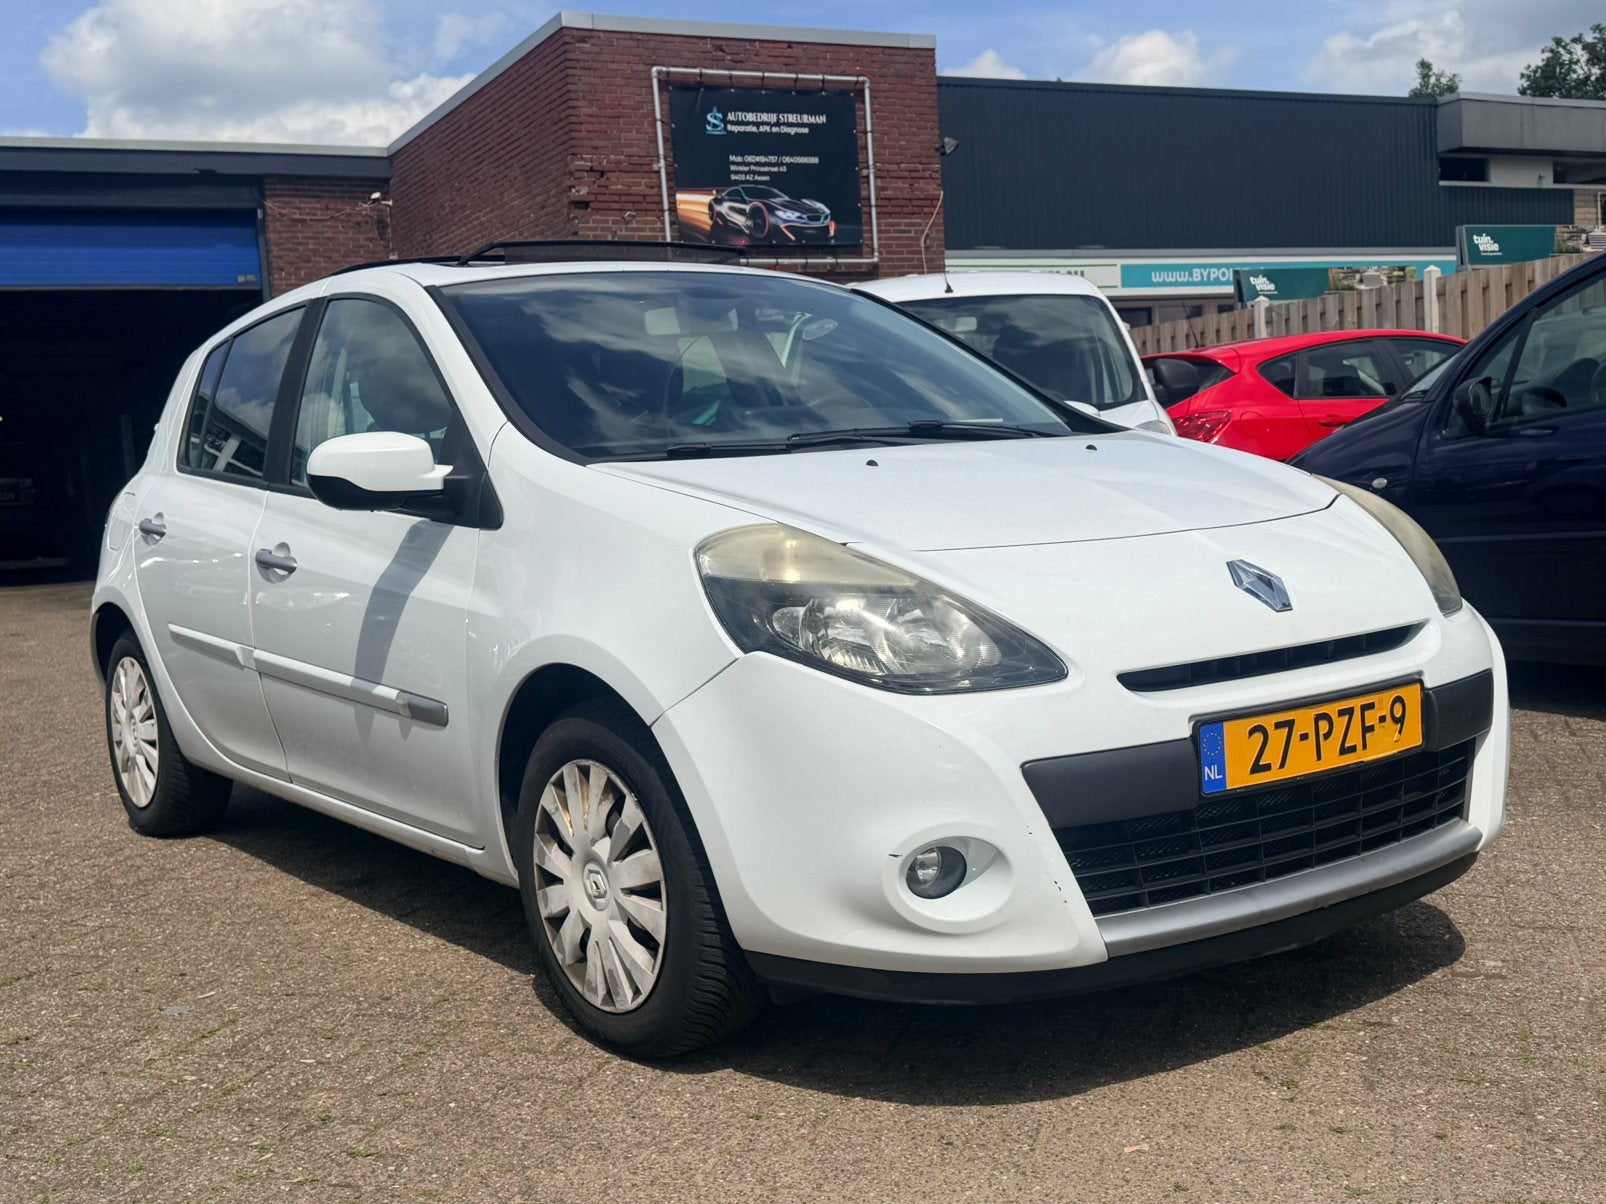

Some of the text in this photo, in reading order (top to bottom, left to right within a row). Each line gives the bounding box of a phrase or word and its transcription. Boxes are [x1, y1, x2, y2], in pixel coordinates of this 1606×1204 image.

[727, 112, 827, 124] AUTOBEDRIJF STREURMAN
[727, 124, 759, 133] Reparatie,
[781, 126, 810, 135] Diagnose
[1246, 694, 1407, 776] 27-PZF-9
[1204, 764, 1223, 781] NL
